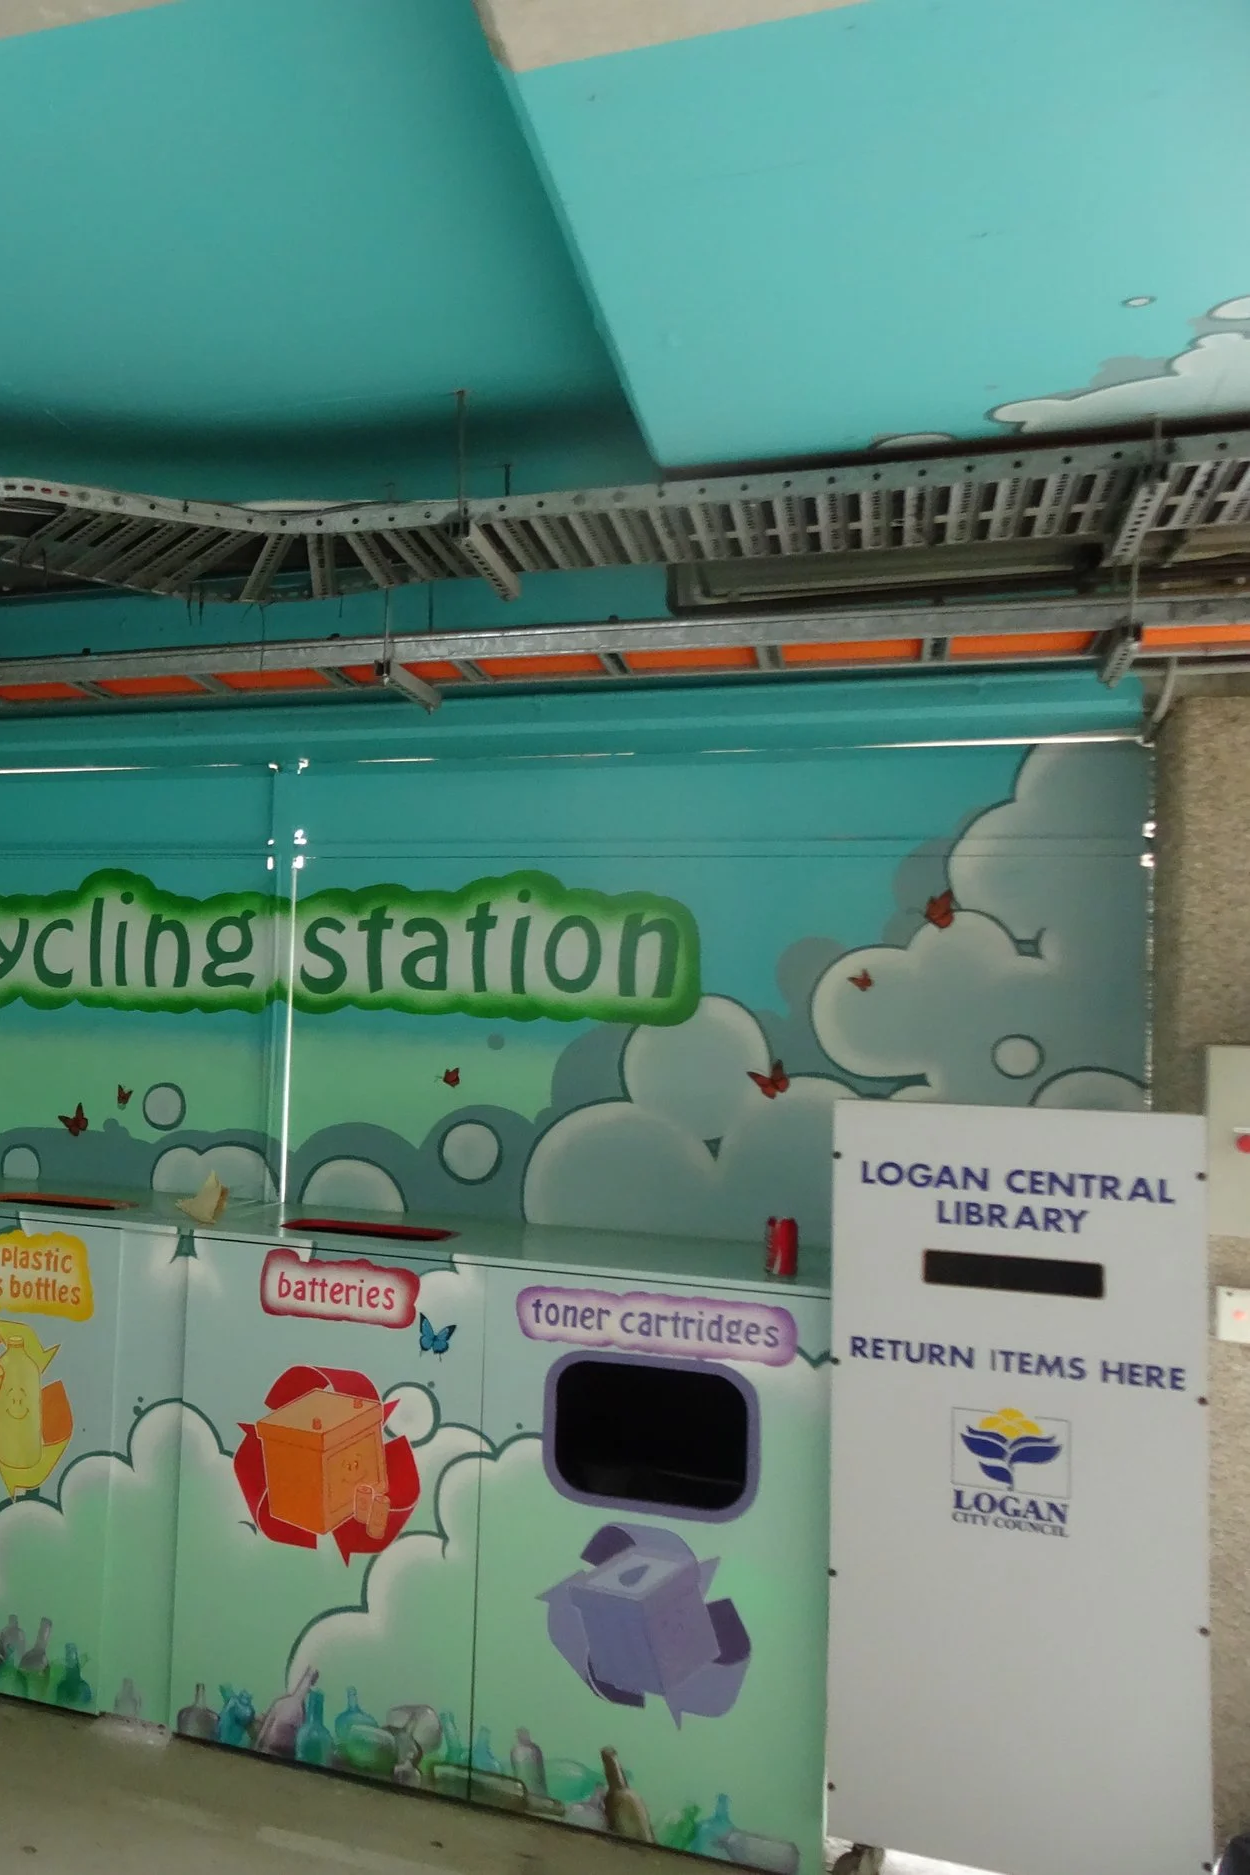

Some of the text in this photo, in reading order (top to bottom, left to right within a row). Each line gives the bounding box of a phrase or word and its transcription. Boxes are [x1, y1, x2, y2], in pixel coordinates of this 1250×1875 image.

[301, 889, 680, 998] station
[861, 1160, 1176, 1205] LOGAN CENTRAL
[936, 1201, 1089, 1234] LIBRARY
[1, 1246, 73, 1274] plastic
[9, 1274, 81, 1306] bottles
[277, 1271, 396, 1312] batteries
[530, 1298, 780, 1348] toner cartridges
[849, 1335, 1186, 1391] RETURN ITEMS HERE
[952, 1511, 1070, 1538] CITY COUNCIL
[953, 1488, 1069, 1524] LOGAN
